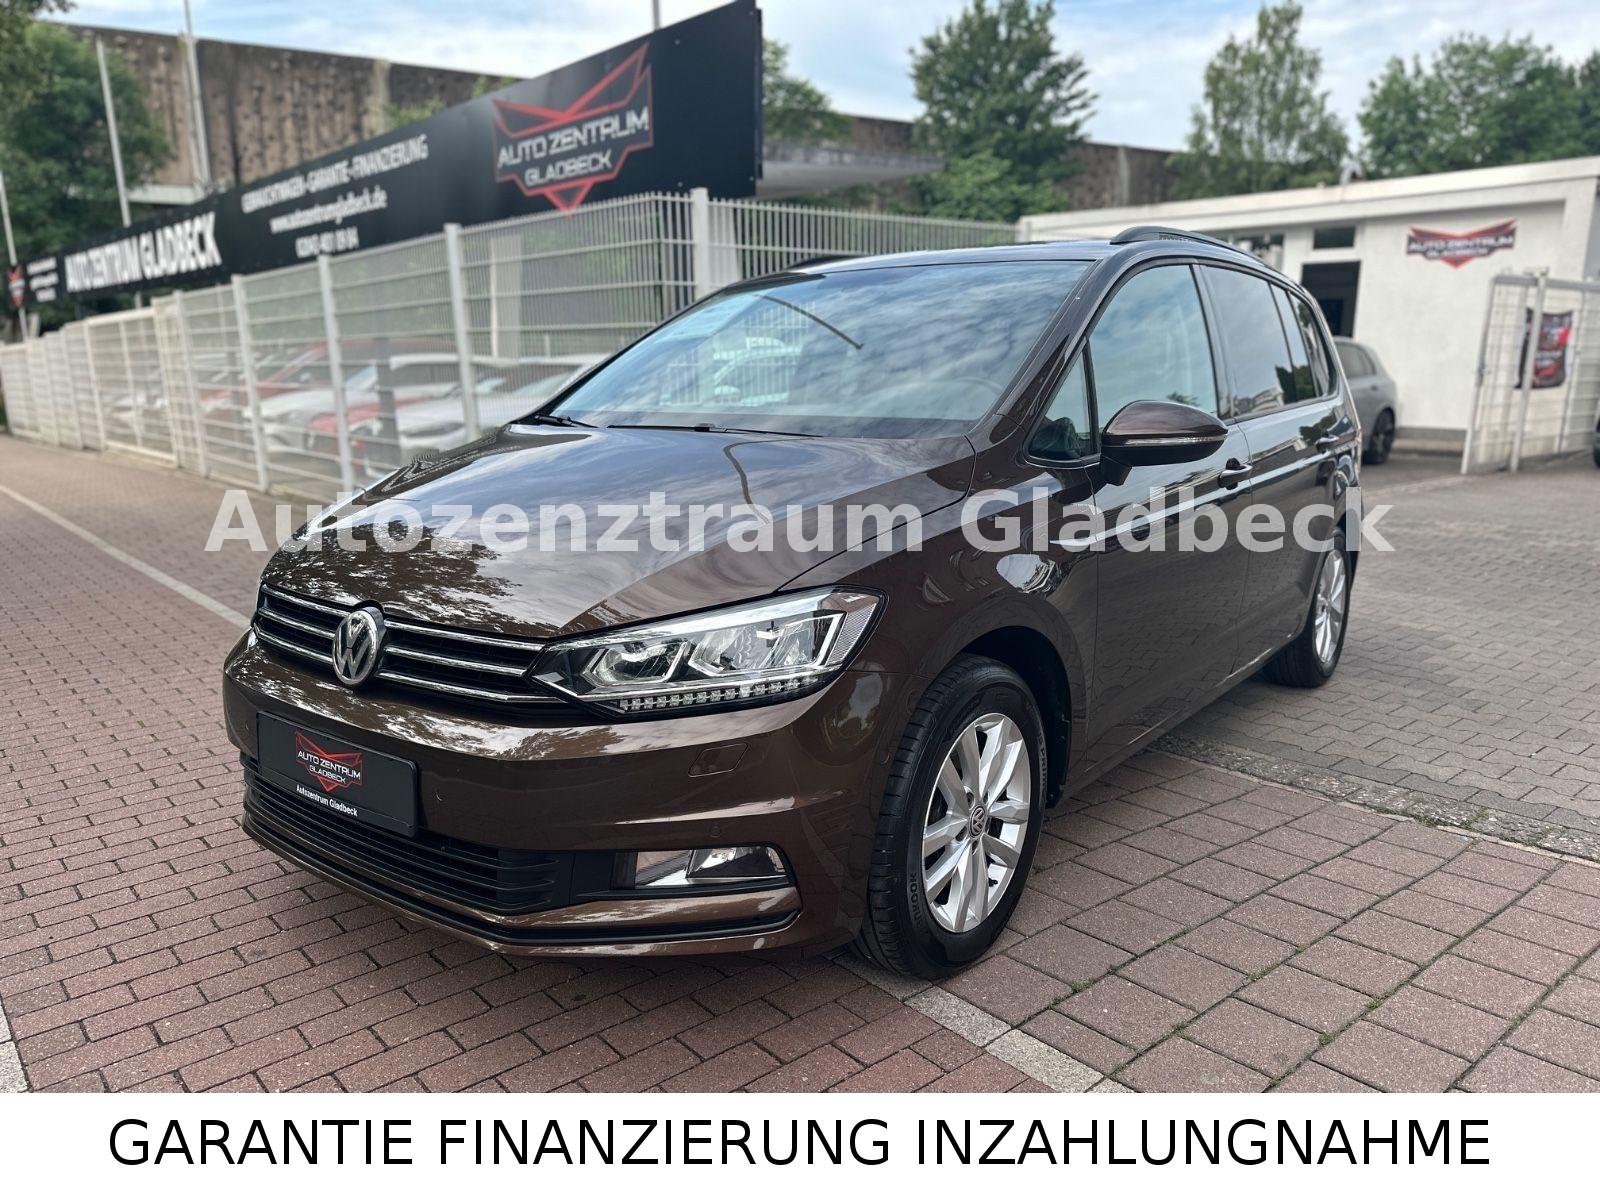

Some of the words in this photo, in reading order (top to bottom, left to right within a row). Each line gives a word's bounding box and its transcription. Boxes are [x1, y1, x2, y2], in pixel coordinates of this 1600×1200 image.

[497, 135, 547, 169] AUTO
[548, 105, 650, 156] ZENTRUM
[524, 148, 613, 188] GLADBECK
[297, 749, 320, 766] AUTO
[320, 757, 361, 781] ZENTRUM
[309, 763, 347, 784] GLADBECK
[296, 784, 329, 807] Autozentrum
[329, 798, 359, 818] Gladbeck
